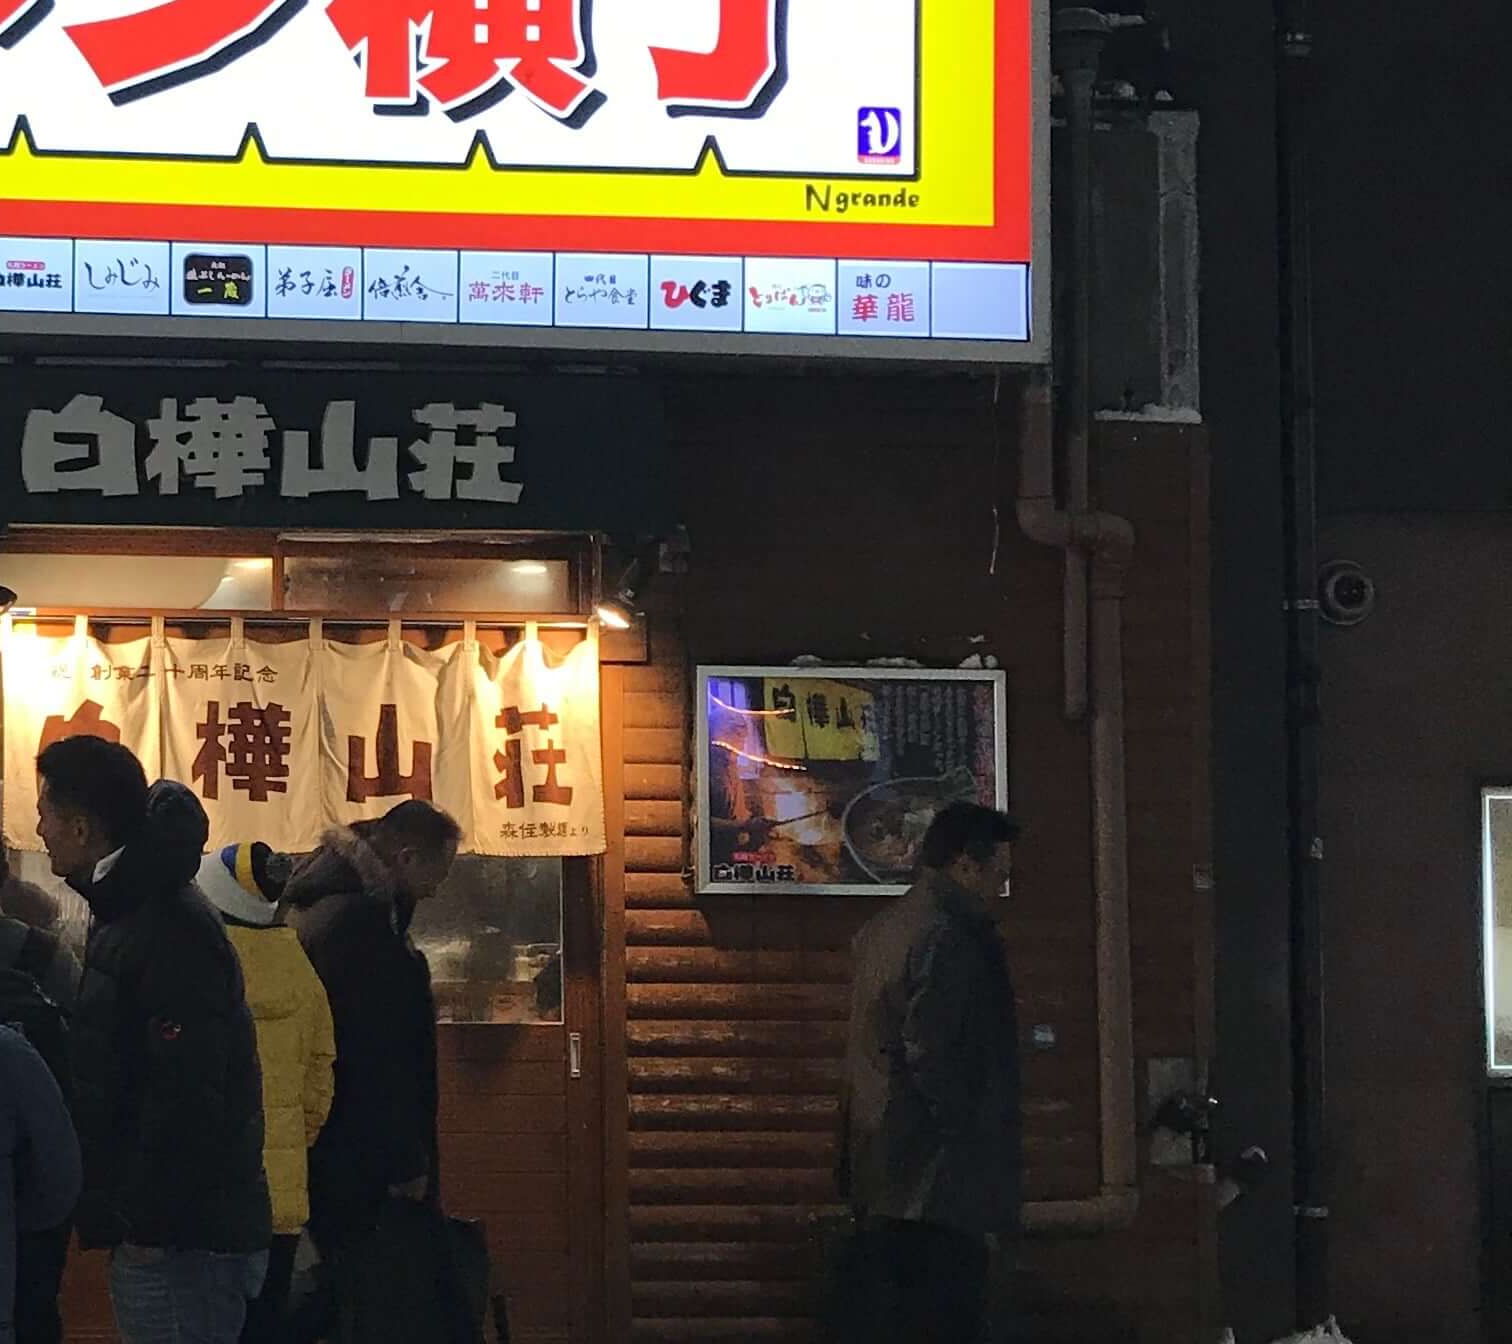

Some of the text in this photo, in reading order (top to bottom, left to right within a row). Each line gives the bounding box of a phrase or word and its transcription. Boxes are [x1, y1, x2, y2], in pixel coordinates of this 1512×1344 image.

[84, 257, 160, 292] しみじみ
[856, 273, 891, 288] 味の
[565, 286, 638, 305] とらや食堂
[660, 280, 731, 308] ひぐま
[852, 293, 915, 322] 華龍
[21, 393, 524, 505] 白樺山荘
